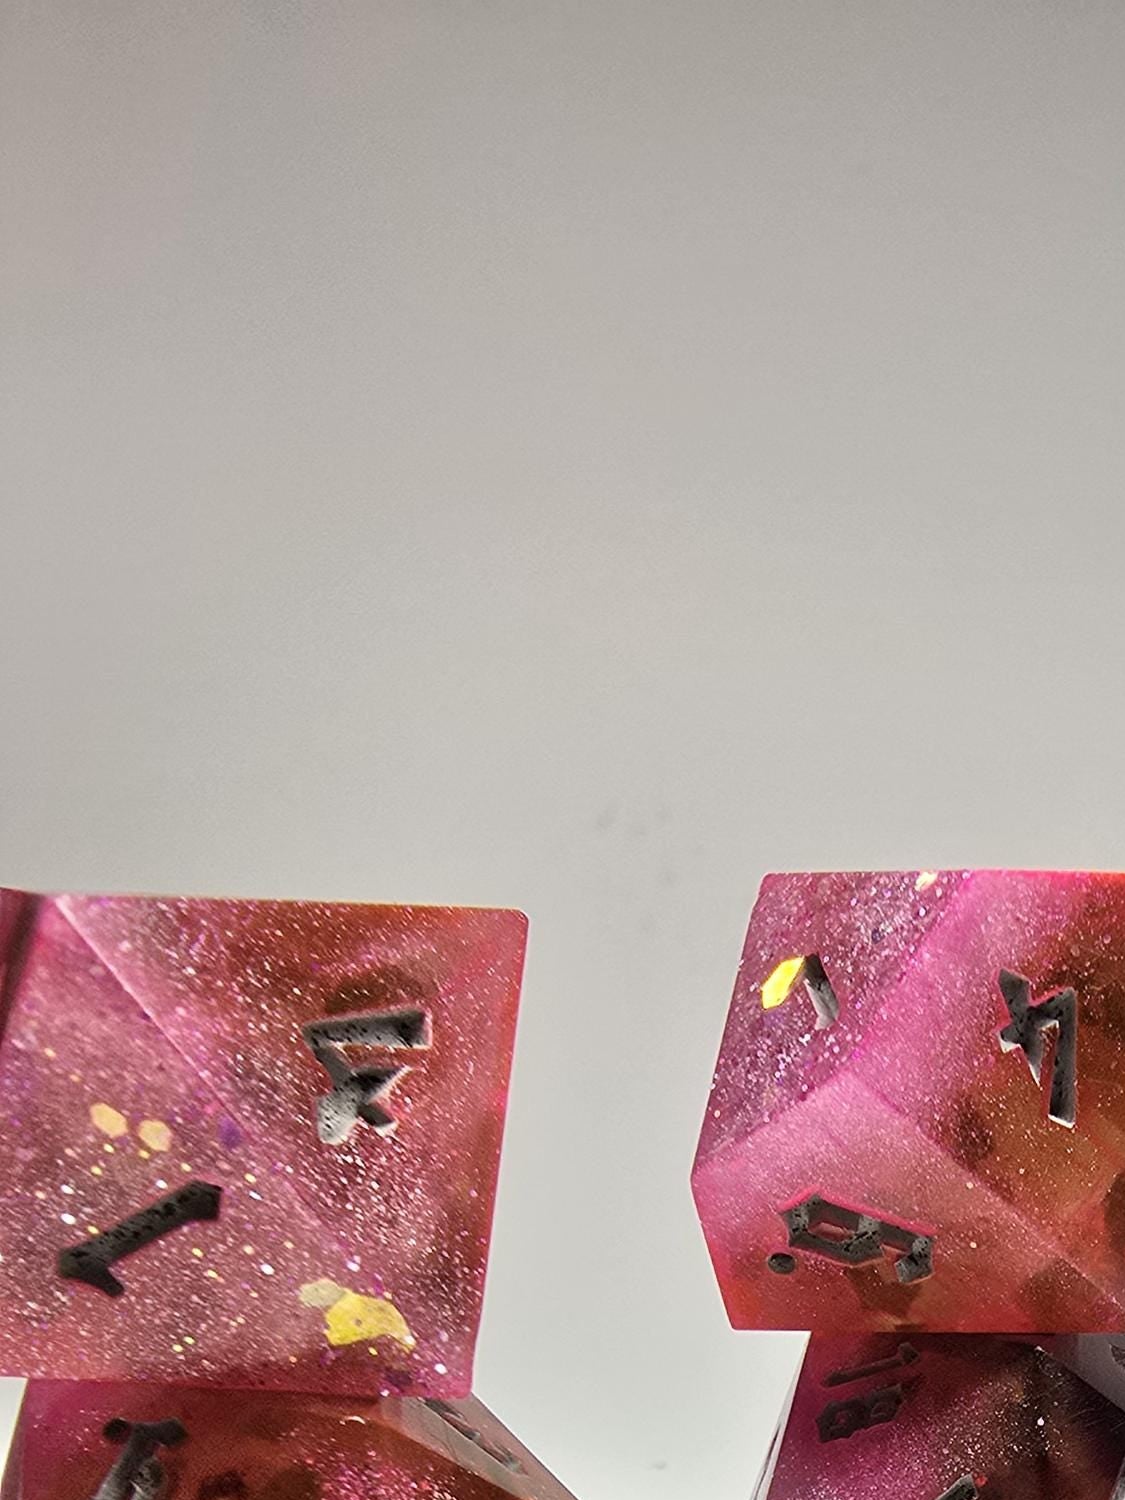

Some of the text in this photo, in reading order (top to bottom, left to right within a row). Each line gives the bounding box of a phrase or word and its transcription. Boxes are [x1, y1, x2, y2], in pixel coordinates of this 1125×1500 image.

[302, 1007, 432, 1145] 4
[998, 967, 1077, 1129] 4
[57, 1180, 223, 1298] 1
